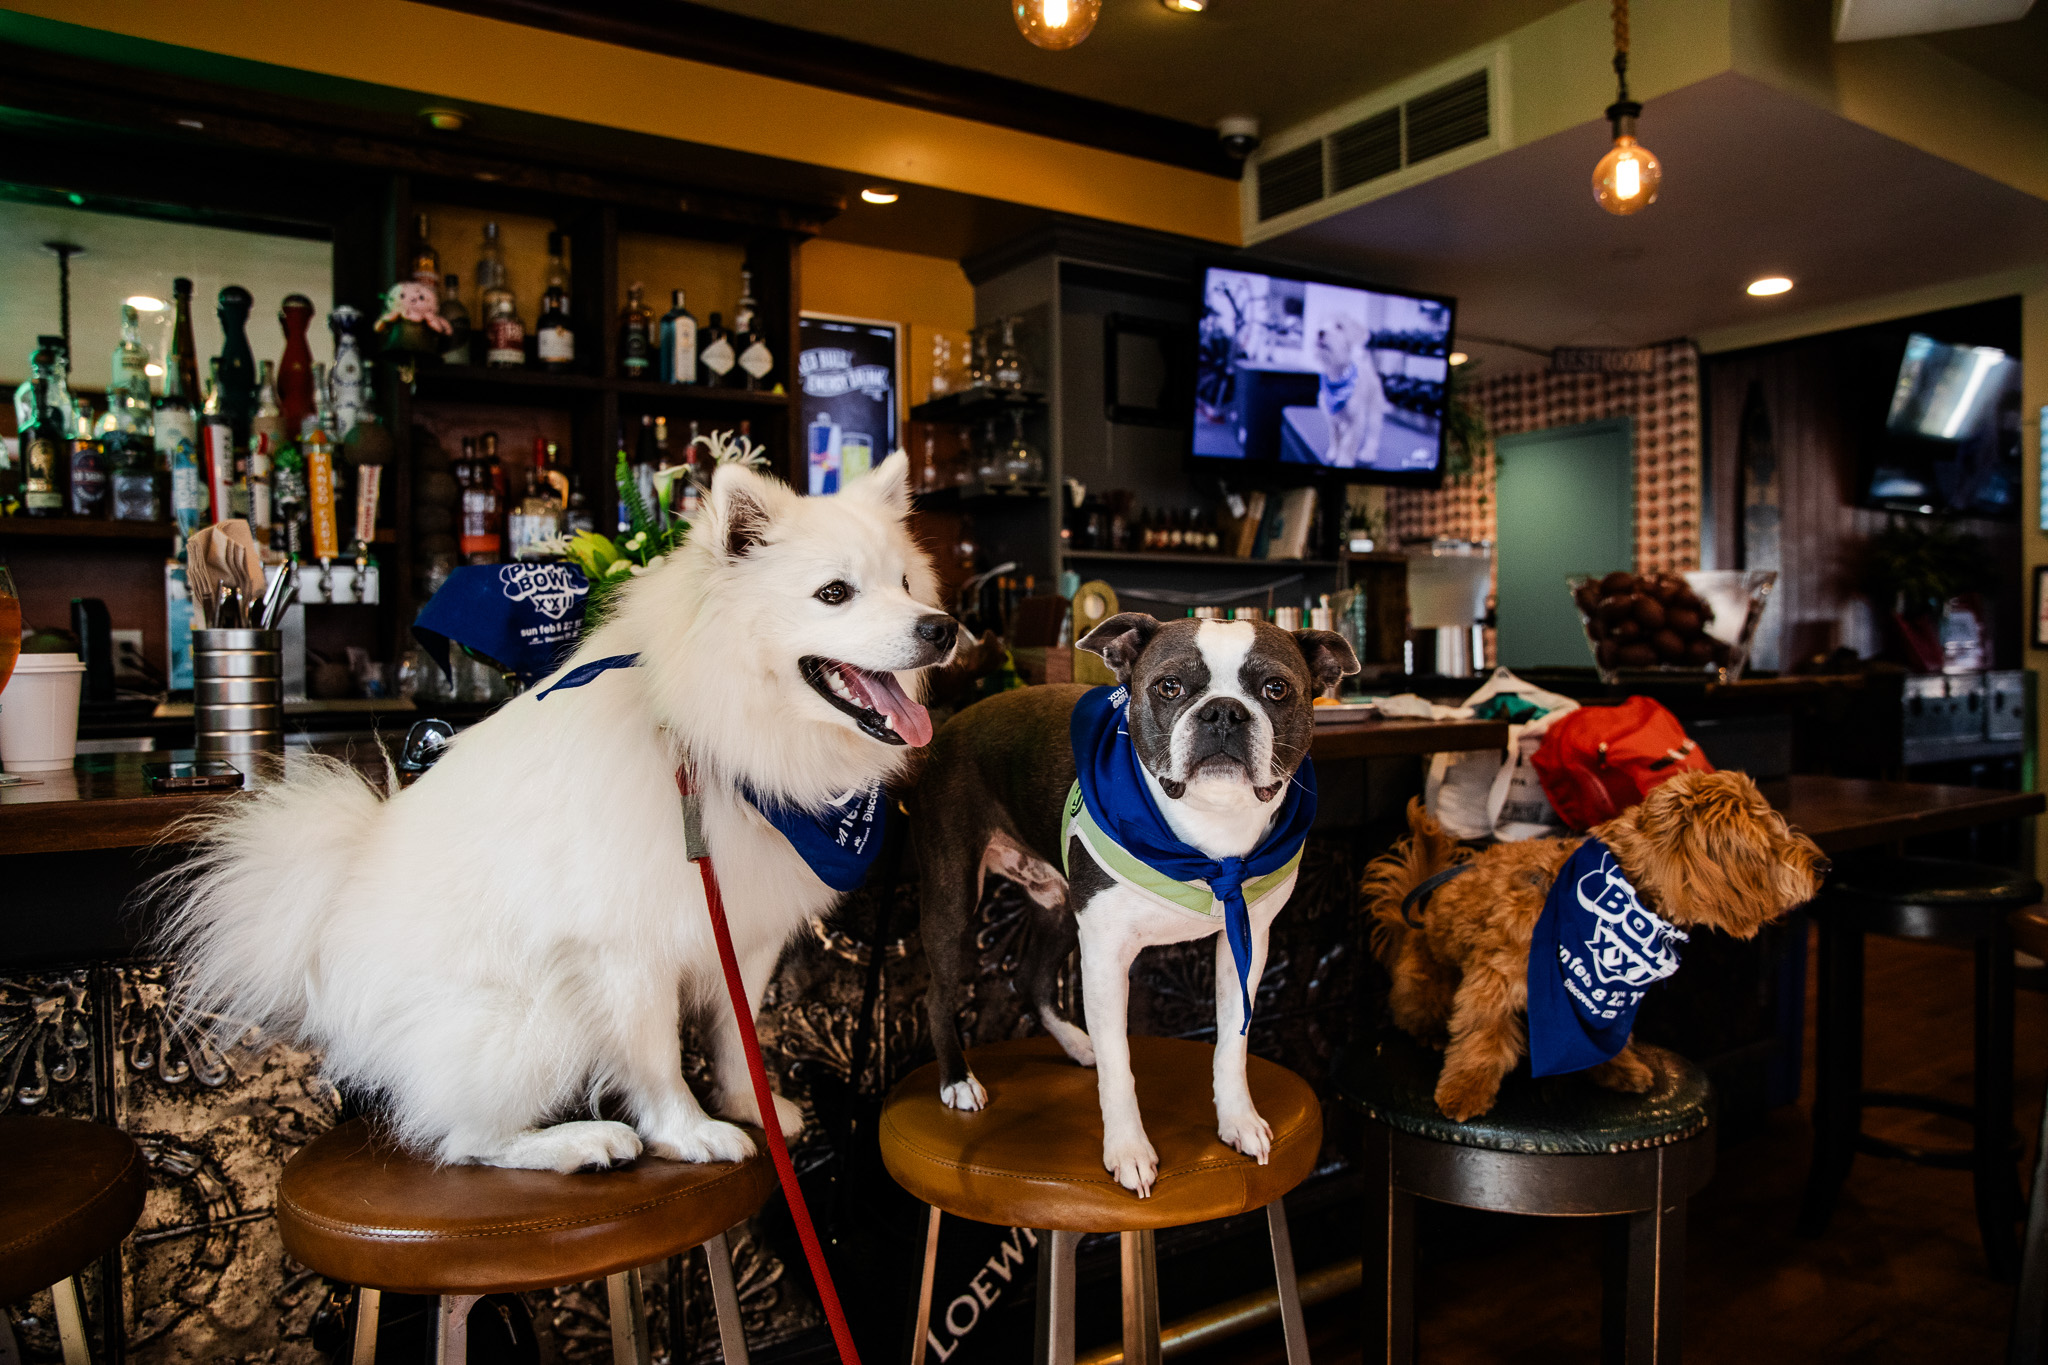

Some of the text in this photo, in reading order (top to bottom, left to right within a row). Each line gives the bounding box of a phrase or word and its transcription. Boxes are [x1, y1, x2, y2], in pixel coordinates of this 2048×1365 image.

[1107, 686, 1126, 702] max
[862, 779, 881, 822] Discove
[1563, 978, 1601, 1015] Discovery
[1568, 956, 1593, 988] feb
[1591, 988, 1607, 1002] 8
